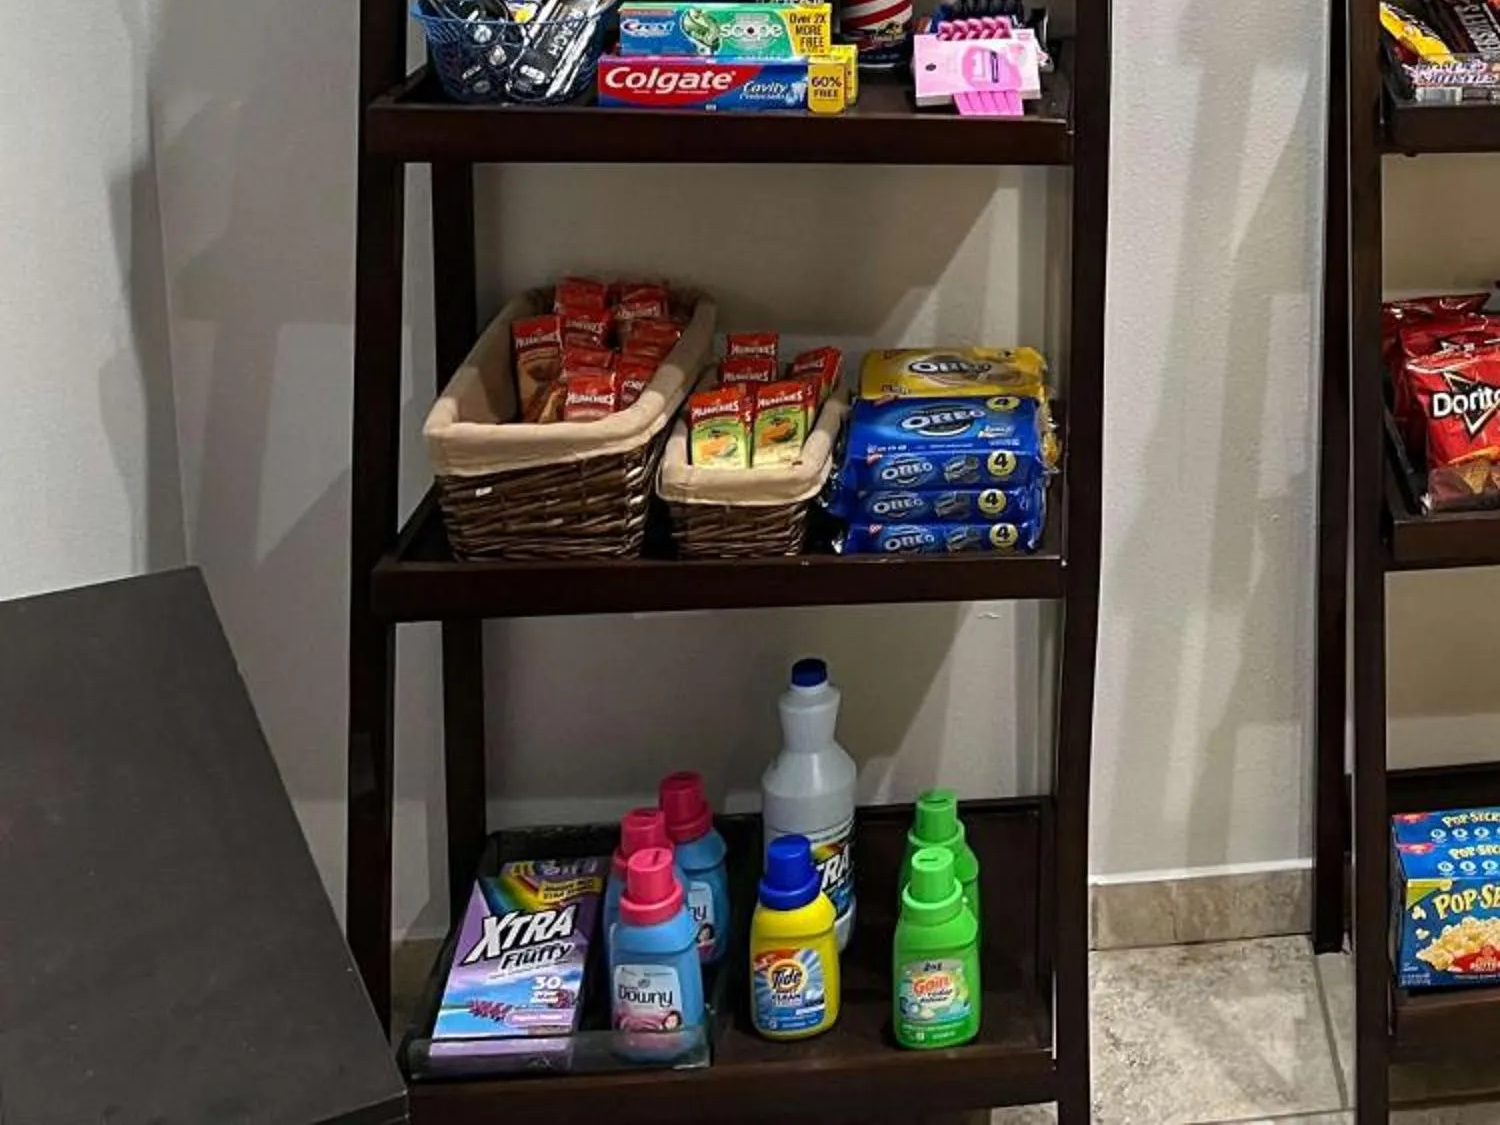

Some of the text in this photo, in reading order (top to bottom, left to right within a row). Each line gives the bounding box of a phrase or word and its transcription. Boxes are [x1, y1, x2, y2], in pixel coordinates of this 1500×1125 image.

[789, 13, 808, 24] Over
[719, 21, 783, 40] scope
[796, 25, 822, 36] MORE
[800, 36, 825, 48] FREE
[605, 65, 732, 95] Colgate
[742, 81, 788, 94] Cavity
[811, 76, 842, 87] 60%
[814, 88, 838, 98] FREE
[911, 361, 992, 374] OREO
[901, 409, 985, 429] OREO
[881, 461, 933, 480] OREO
[873, 497, 924, 514] OREO
[884, 534, 935, 552] OREO
[462, 905, 577, 964] XTRA
[501, 942, 574, 970] Fluffy
[532, 976, 561, 990] 30
[618, 984, 673, 1008] Downy
